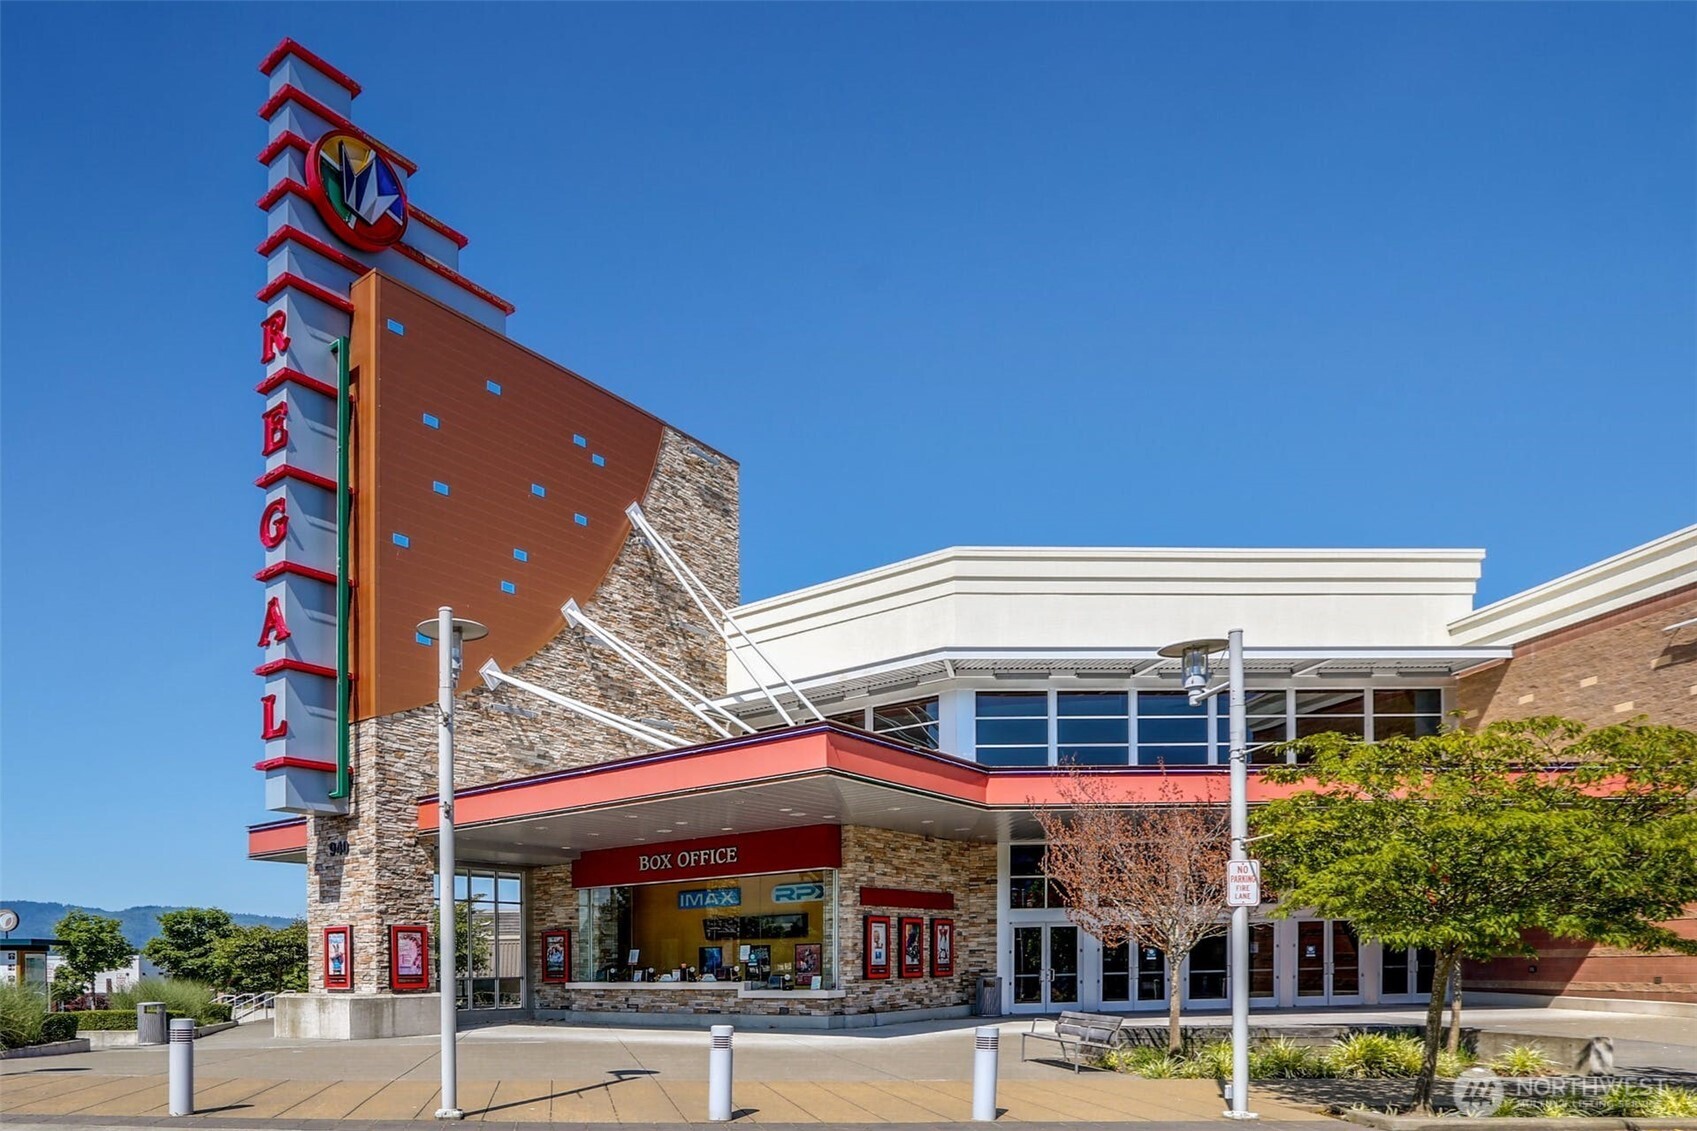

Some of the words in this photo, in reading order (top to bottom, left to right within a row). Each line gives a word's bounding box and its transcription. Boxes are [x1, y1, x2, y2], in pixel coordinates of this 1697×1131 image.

[258, 309, 291, 740] REGAL
[329, 840, 350, 856] 940
[639, 853, 672, 872] BOX
[677, 847, 738, 868] OFFICE
[1237, 865, 1248, 873] NO
[680, 891, 734, 908] IMAX
